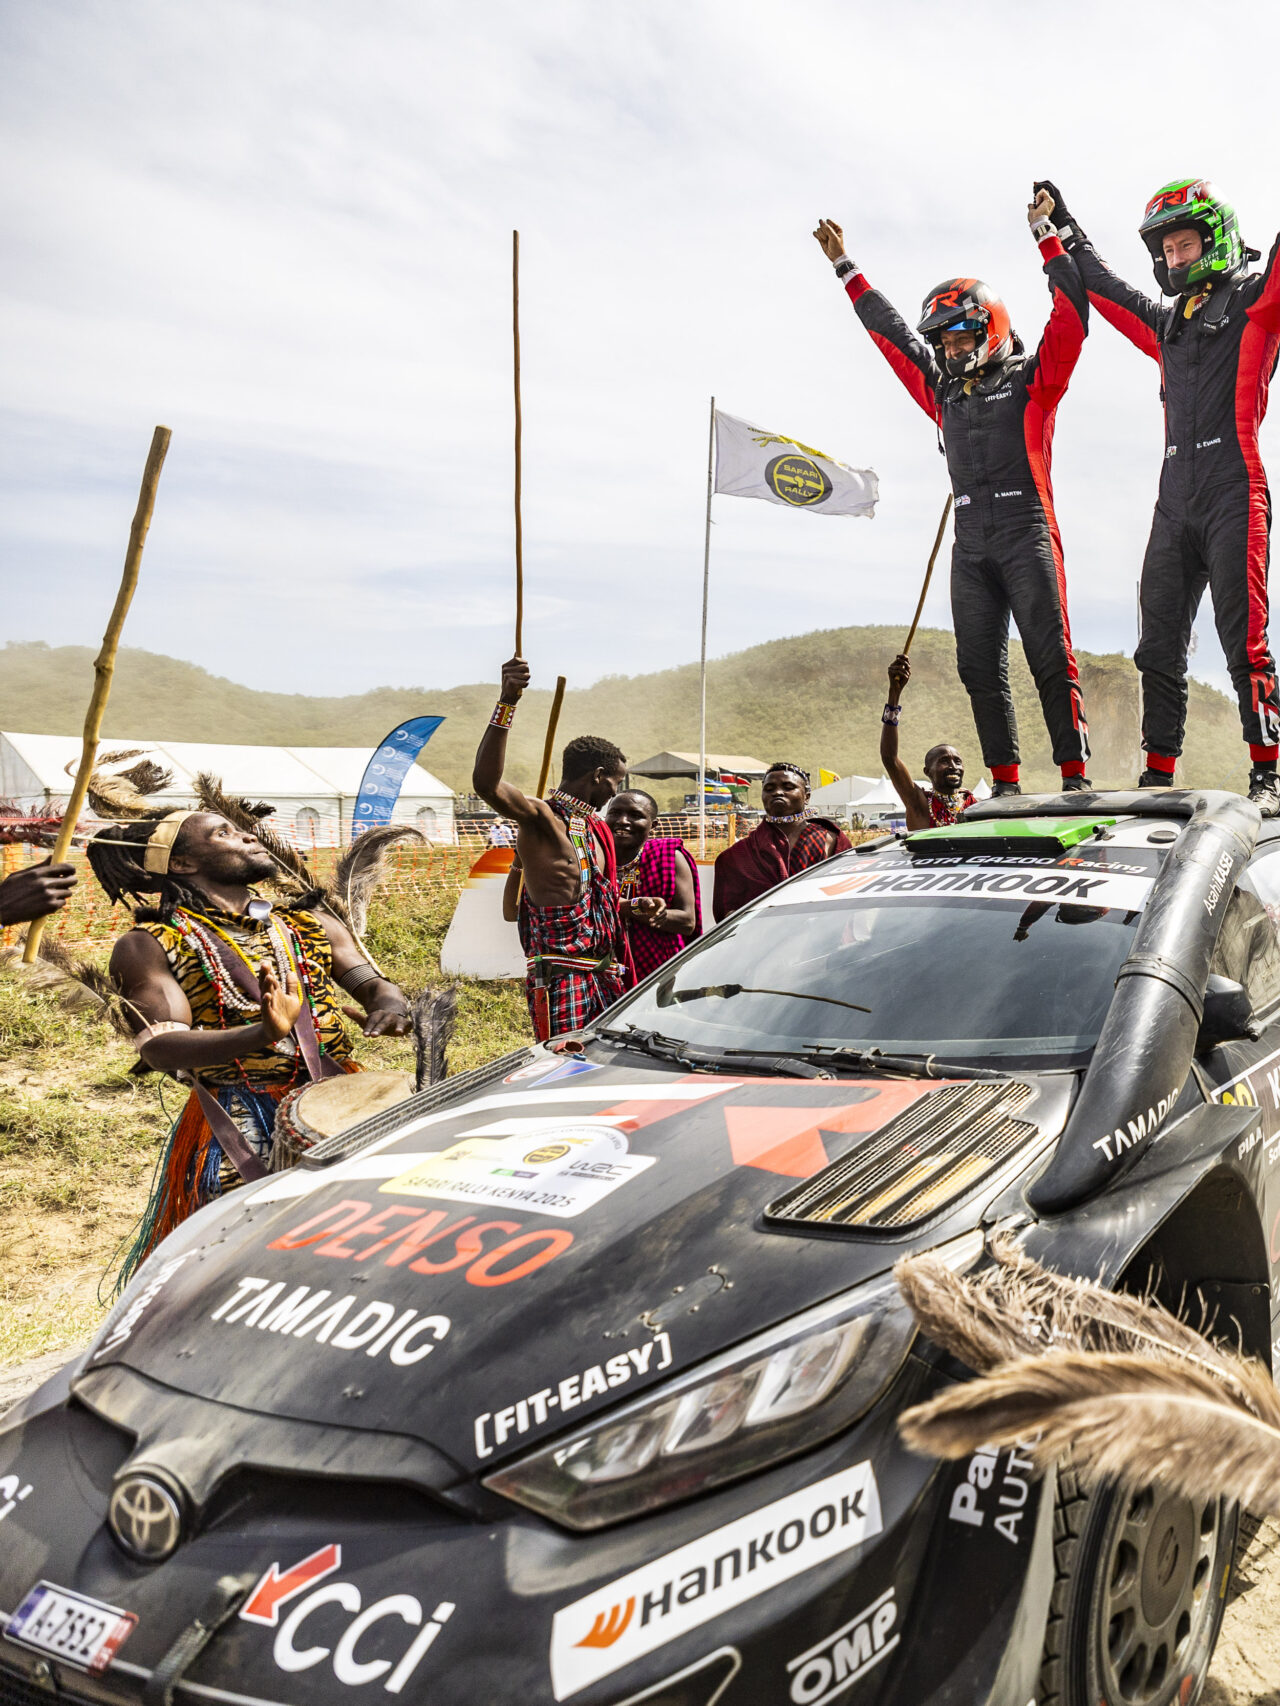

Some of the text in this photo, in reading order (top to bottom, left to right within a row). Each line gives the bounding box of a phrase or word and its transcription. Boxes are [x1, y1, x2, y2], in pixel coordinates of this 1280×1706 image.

[1203, 437, 1221, 447] EVANS
[783, 464, 818, 479] SAFARI
[784, 486, 814, 497] RALLY
[877, 856, 962, 869] TOYOTA
[966, 855, 1056, 866] GAZOO
[1058, 857, 1148, 874] Racing
[1092, 1087, 1179, 1162] TAMADIC
[1237, 1126, 1263, 1161] PIAA
[568, 1160, 633, 1176] WRC
[487, 1186, 538, 1202] KENYA
[532, 1192, 577, 1208] 2025
[266, 1199, 574, 1288] DENSO
[210, 1276, 452, 1367] TAMADIC
[789, 1599, 899, 1705] OMP
